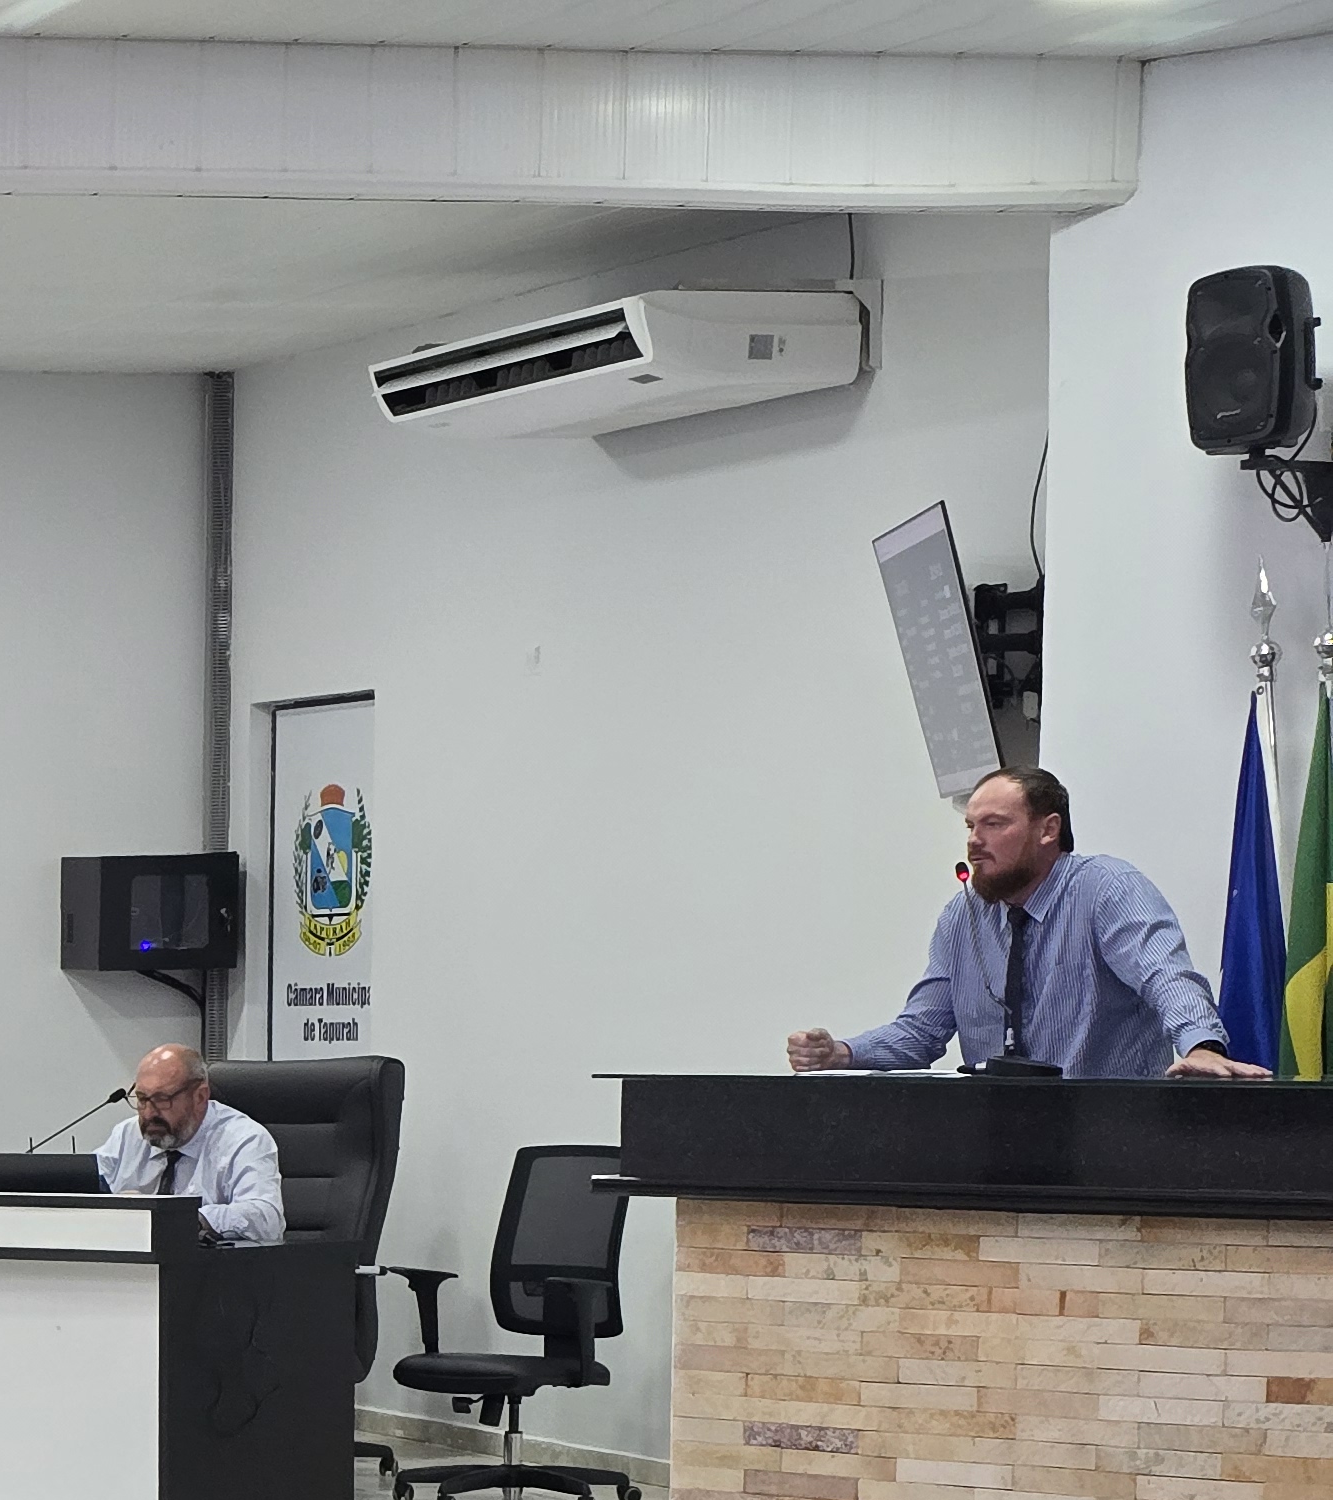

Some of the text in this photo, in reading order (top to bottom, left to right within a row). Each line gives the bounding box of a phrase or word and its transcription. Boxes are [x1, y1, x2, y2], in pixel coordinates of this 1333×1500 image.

[307, 917, 351, 938] TAPURAH
[286, 981, 324, 1007] Câmara
[303, 1017, 359, 1044] de Tapurah
